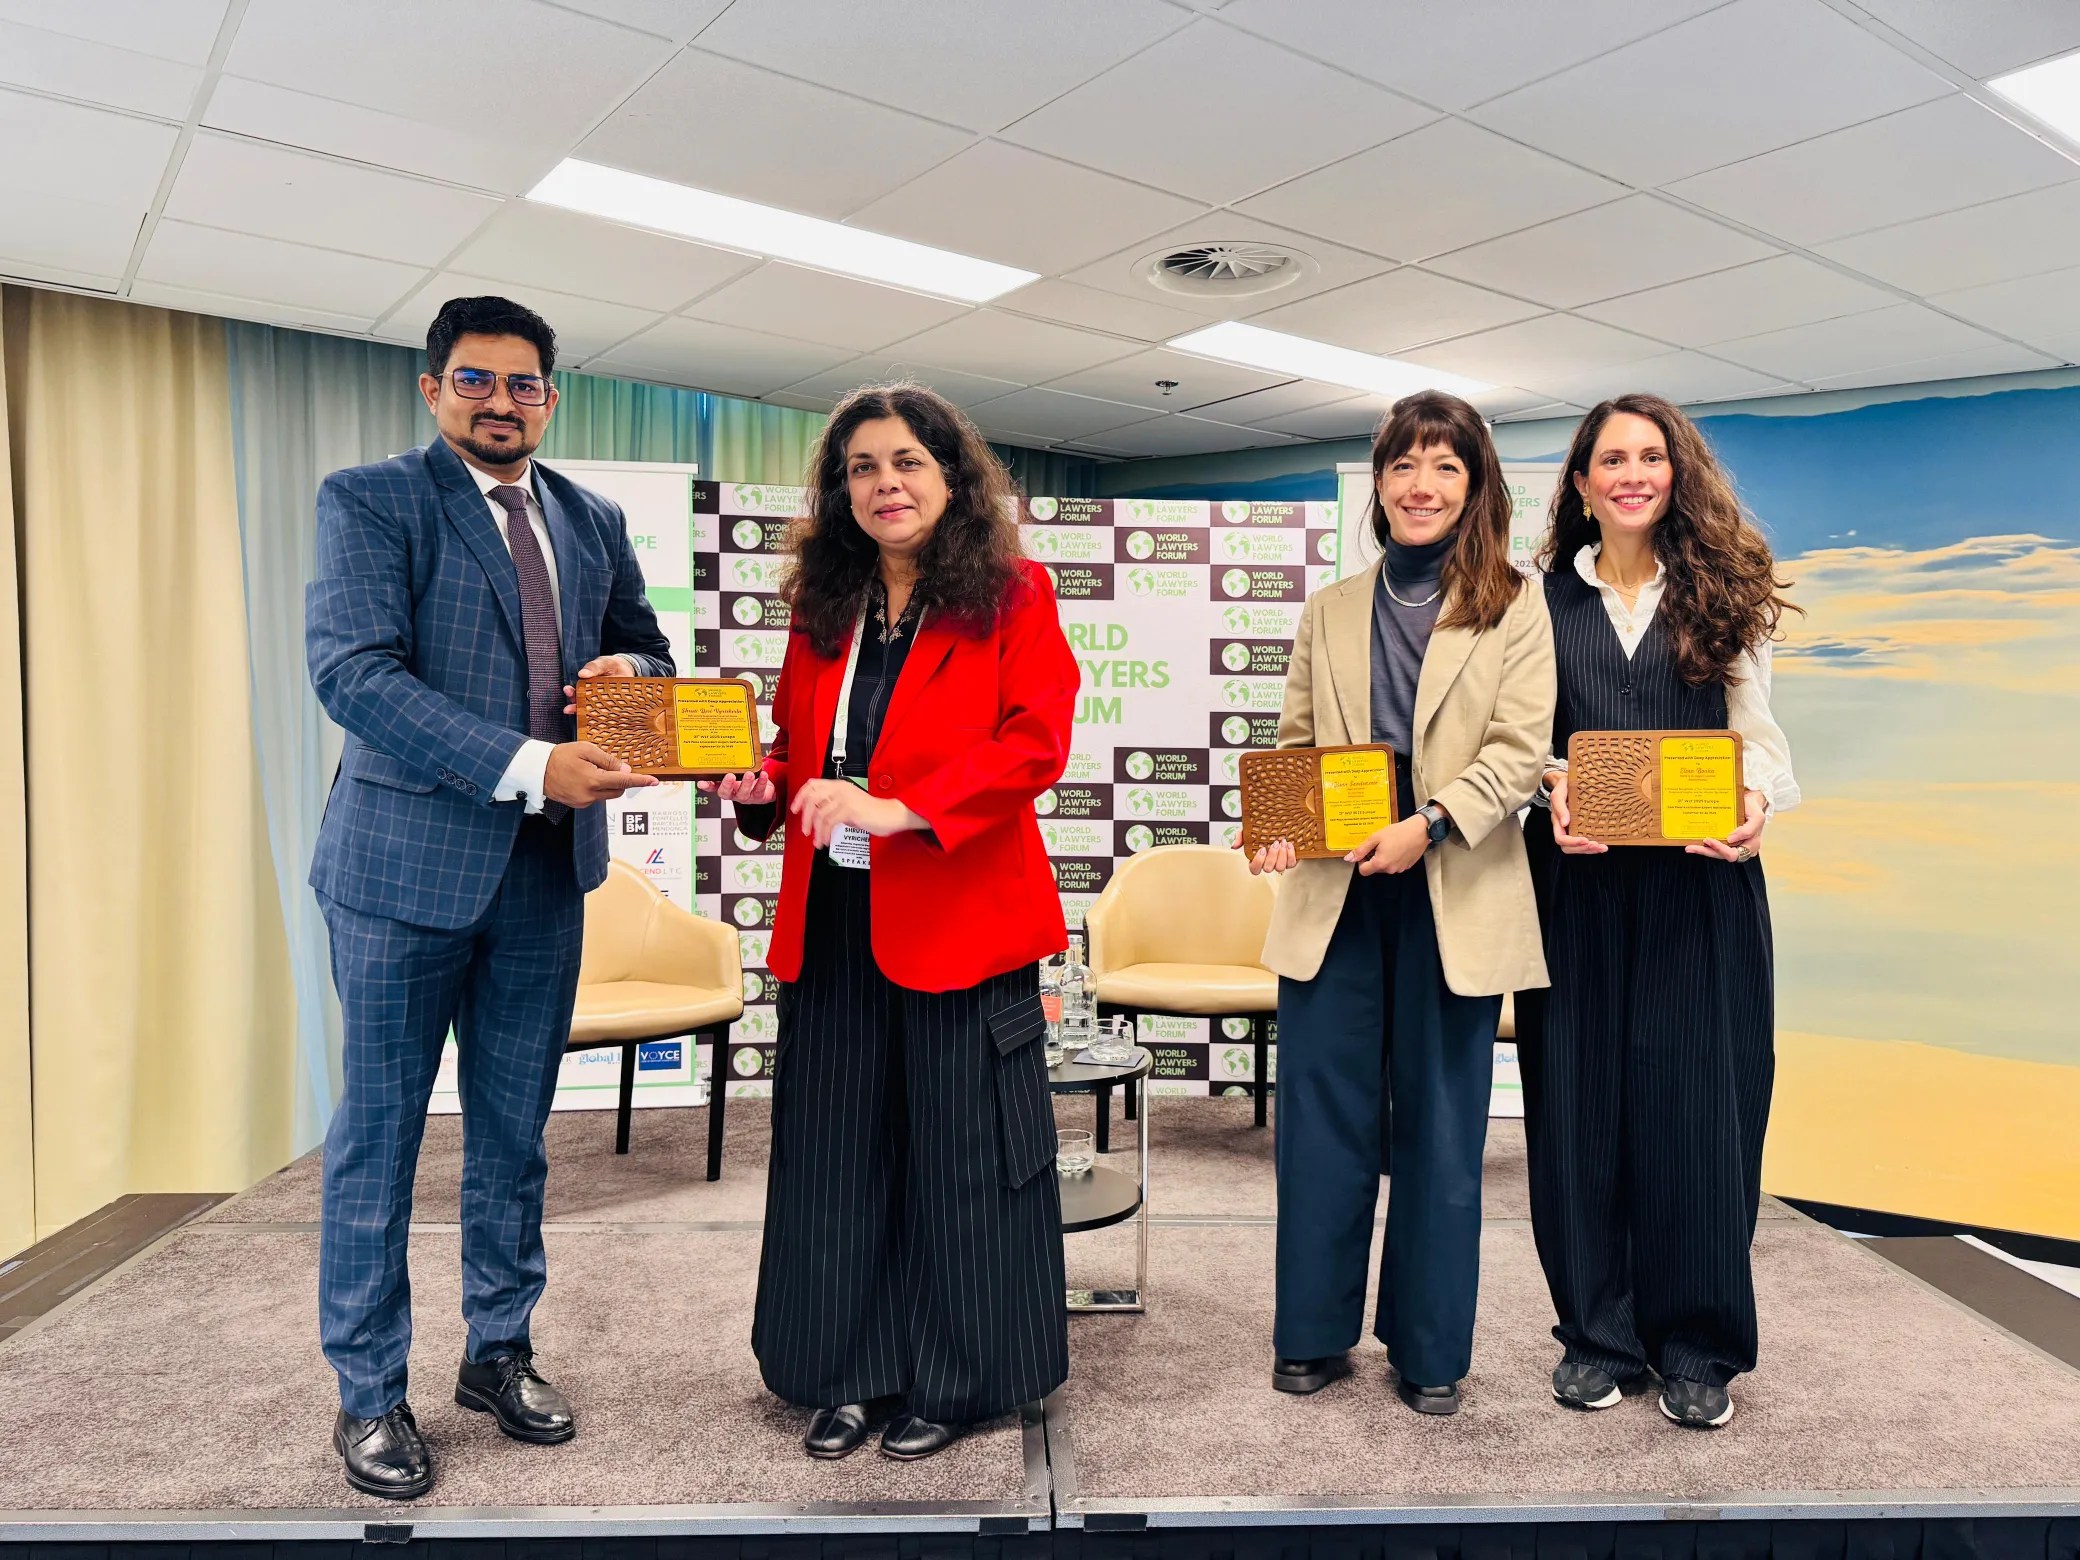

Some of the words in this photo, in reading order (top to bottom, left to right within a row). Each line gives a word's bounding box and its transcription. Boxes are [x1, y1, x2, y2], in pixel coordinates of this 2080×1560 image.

[765, 486, 797, 494] WORLD
[1060, 505, 1102, 513] LAWYERS
[1252, 507, 1294, 515] LAWYERS
[1157, 533, 1188, 541] WORLD
[1253, 534, 1283, 542] WORLD
[1156, 543, 1198, 551] LAWYERS
[1252, 544, 1293, 552] LAWYERS
[1060, 569, 1092, 577] WORLD
[1252, 572, 1283, 580] WORLD
[1060, 579, 1102, 587] LAWYERS
[1157, 580, 1198, 588] LAWYERS
[1252, 581, 1294, 589] LAWYERS
[1060, 588, 1090, 596] FORUM
[1252, 590, 1282, 598] FORUM
[1252, 618, 1293, 626] LAWYERS
[1065, 623, 1129, 651] RLD
[1252, 646, 1283, 654] WORLD
[1252, 664, 1282, 672] FORUM
[1082, 660, 1170, 689] YERS
[1252, 728, 1278, 736] LAWY
[1060, 789, 1091, 797] WORLD
[1059, 799, 1102, 807] LAWYERS
[626, 814, 643, 823] BF
[626, 824, 645, 832] BM
[1060, 863, 1091, 871] WORLD
[1059, 872, 1101, 880] LAWYERS
[1156, 1021, 1197, 1029] LAWYERS
[640, 1050, 680, 1060] VOYCE
[1155, 1049, 1187, 1057] WORLD
[1495, 1053, 1518, 1064] glob
[1155, 1059, 1198, 1067] LAWYERS
